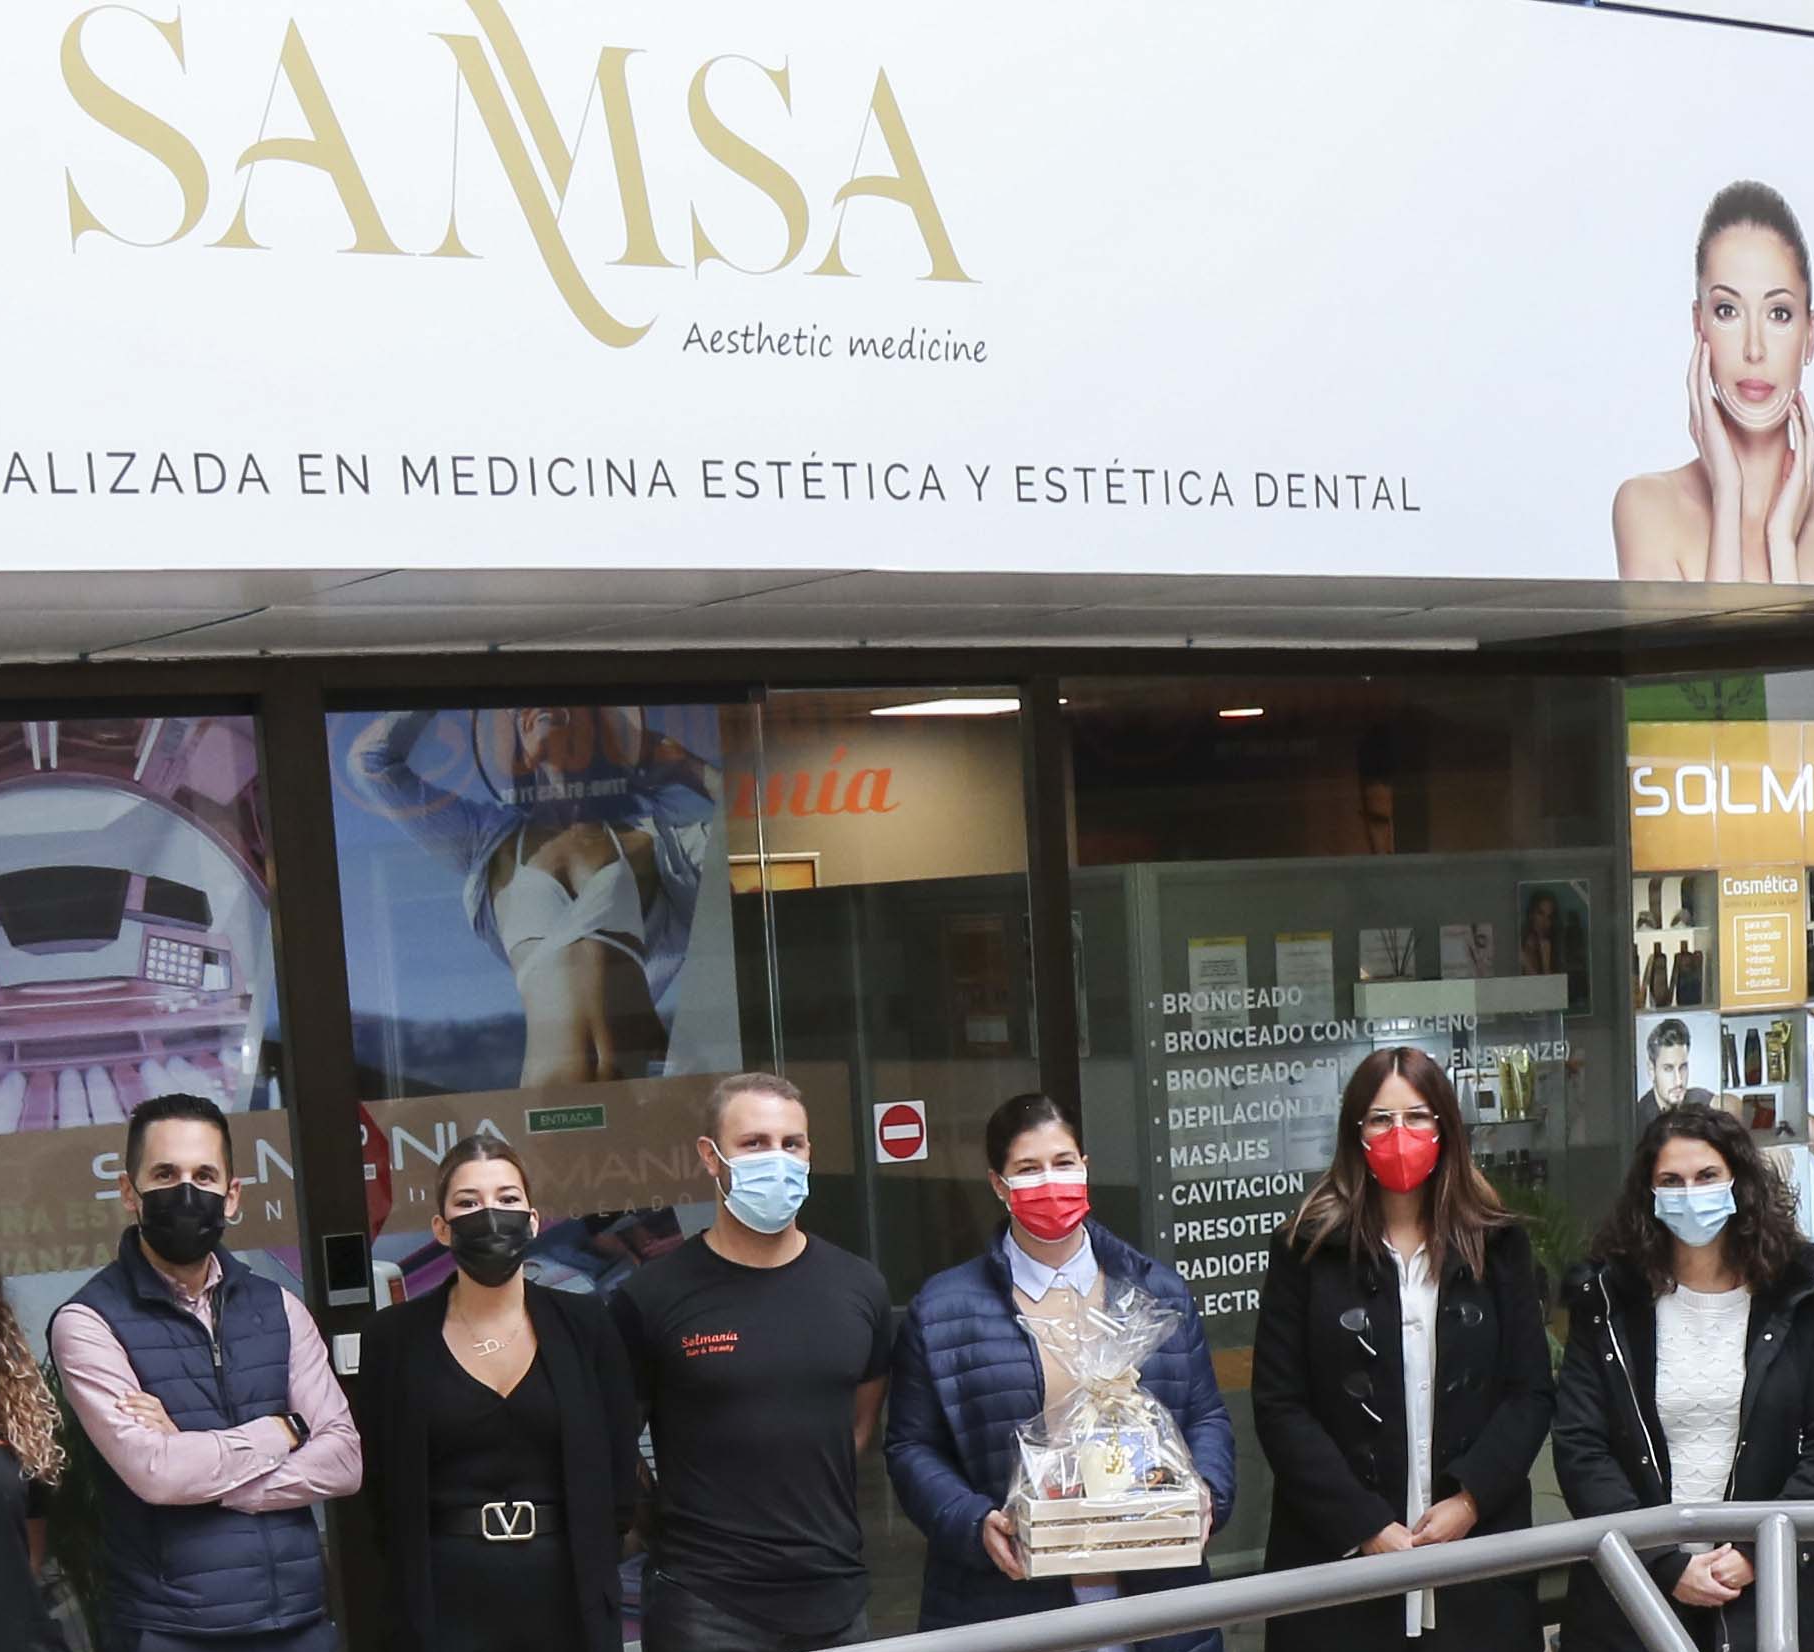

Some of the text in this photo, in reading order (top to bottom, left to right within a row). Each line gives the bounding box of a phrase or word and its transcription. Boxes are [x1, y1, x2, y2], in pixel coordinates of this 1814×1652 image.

[61, 0, 982, 348] SAMSA
[682, 320, 988, 366] Aesthetic medicine
[298, 453, 371, 495] EN
[401, 455, 678, 499] MEDICINA
[701, 450, 946, 502] ESTÉTICA
[965, 465, 991, 502] Y
[1014, 457, 1237, 509] ESTÉTICA
[1258, 471, 1422, 513] DENTAL
[1722, 874, 1799, 896] Cosmética
[1161, 985, 1303, 1015] BRONCEADO
[1164, 1023, 1304, 1053] BRONCEADO
[1311, 1018, 1357, 1042] CON
[1165, 1061, 1307, 1093] BRONCEADO
[538, 1110, 595, 1127] ENTRADA
[1167, 1094, 1302, 1132] DEPILACIÓN
[1169, 1138, 1270, 1169] MASAJES
[1171, 1168, 1305, 1207] CAVITACIÓN
